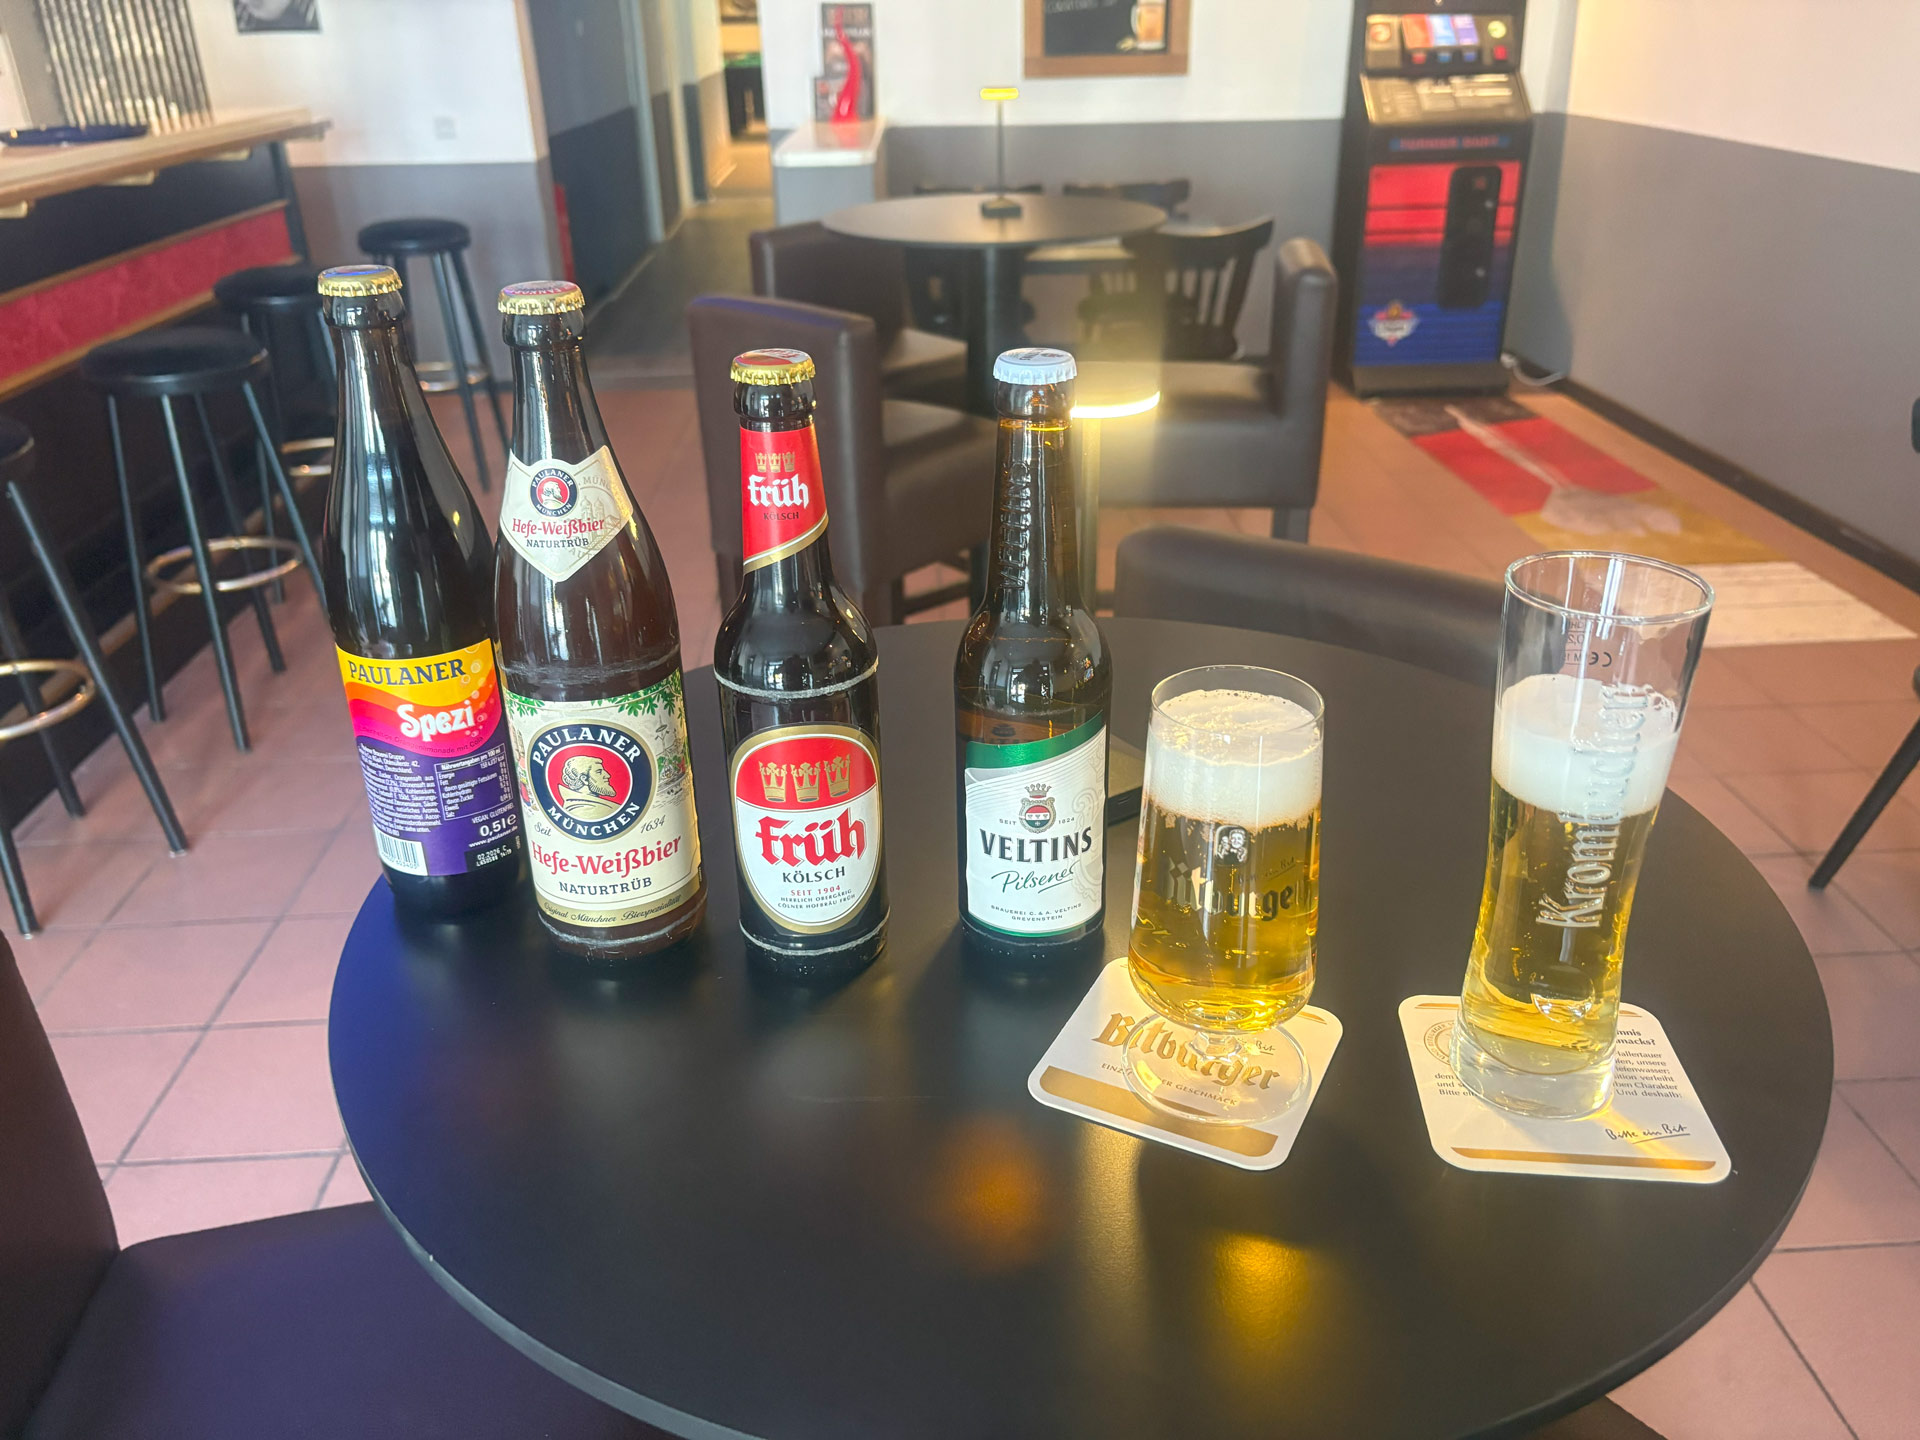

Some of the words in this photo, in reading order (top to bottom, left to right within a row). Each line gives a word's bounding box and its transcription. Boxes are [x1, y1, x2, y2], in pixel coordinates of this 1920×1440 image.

[530, 468, 574, 488] PAULANER
[536, 502, 573, 517] MÜNCHEN
[763, 511, 800, 521] KÖLSCH
[512, 517, 605, 539] Hefe-Weißbier
[526, 537, 590, 549] NATURTRÜB
[348, 658, 466, 686] PAULANER
[397, 700, 474, 742] Spezi
[532, 727, 641, 767] PAULANER
[533, 822, 552, 837] Seit
[640, 814, 666, 834] 1634
[547, 801, 641, 837] MÜNCHEN
[999, 817, 1016, 826] SEIT
[979, 826, 1092, 863] VELTINS
[531, 835, 682, 878] Hefe-Weißbier
[782, 866, 846, 884] KÖLSCH
[558, 877, 652, 896] NATURTRÜB
[790, 888, 812, 897] SEIT
[817, 884, 841, 896] 1904
[805, 899, 838, 909] HOFBRÄU
[990, 904, 1027, 916] BRAUEREI
[1054, 902, 1082, 915] VELTINS
[570, 908, 617, 923] Münchner
[1011, 914, 1063, 922] GREVENSTEIN
[1634, 1081, 1678, 1090] Charakter
[1175, 1083, 1239, 1107] GESCHMACK
